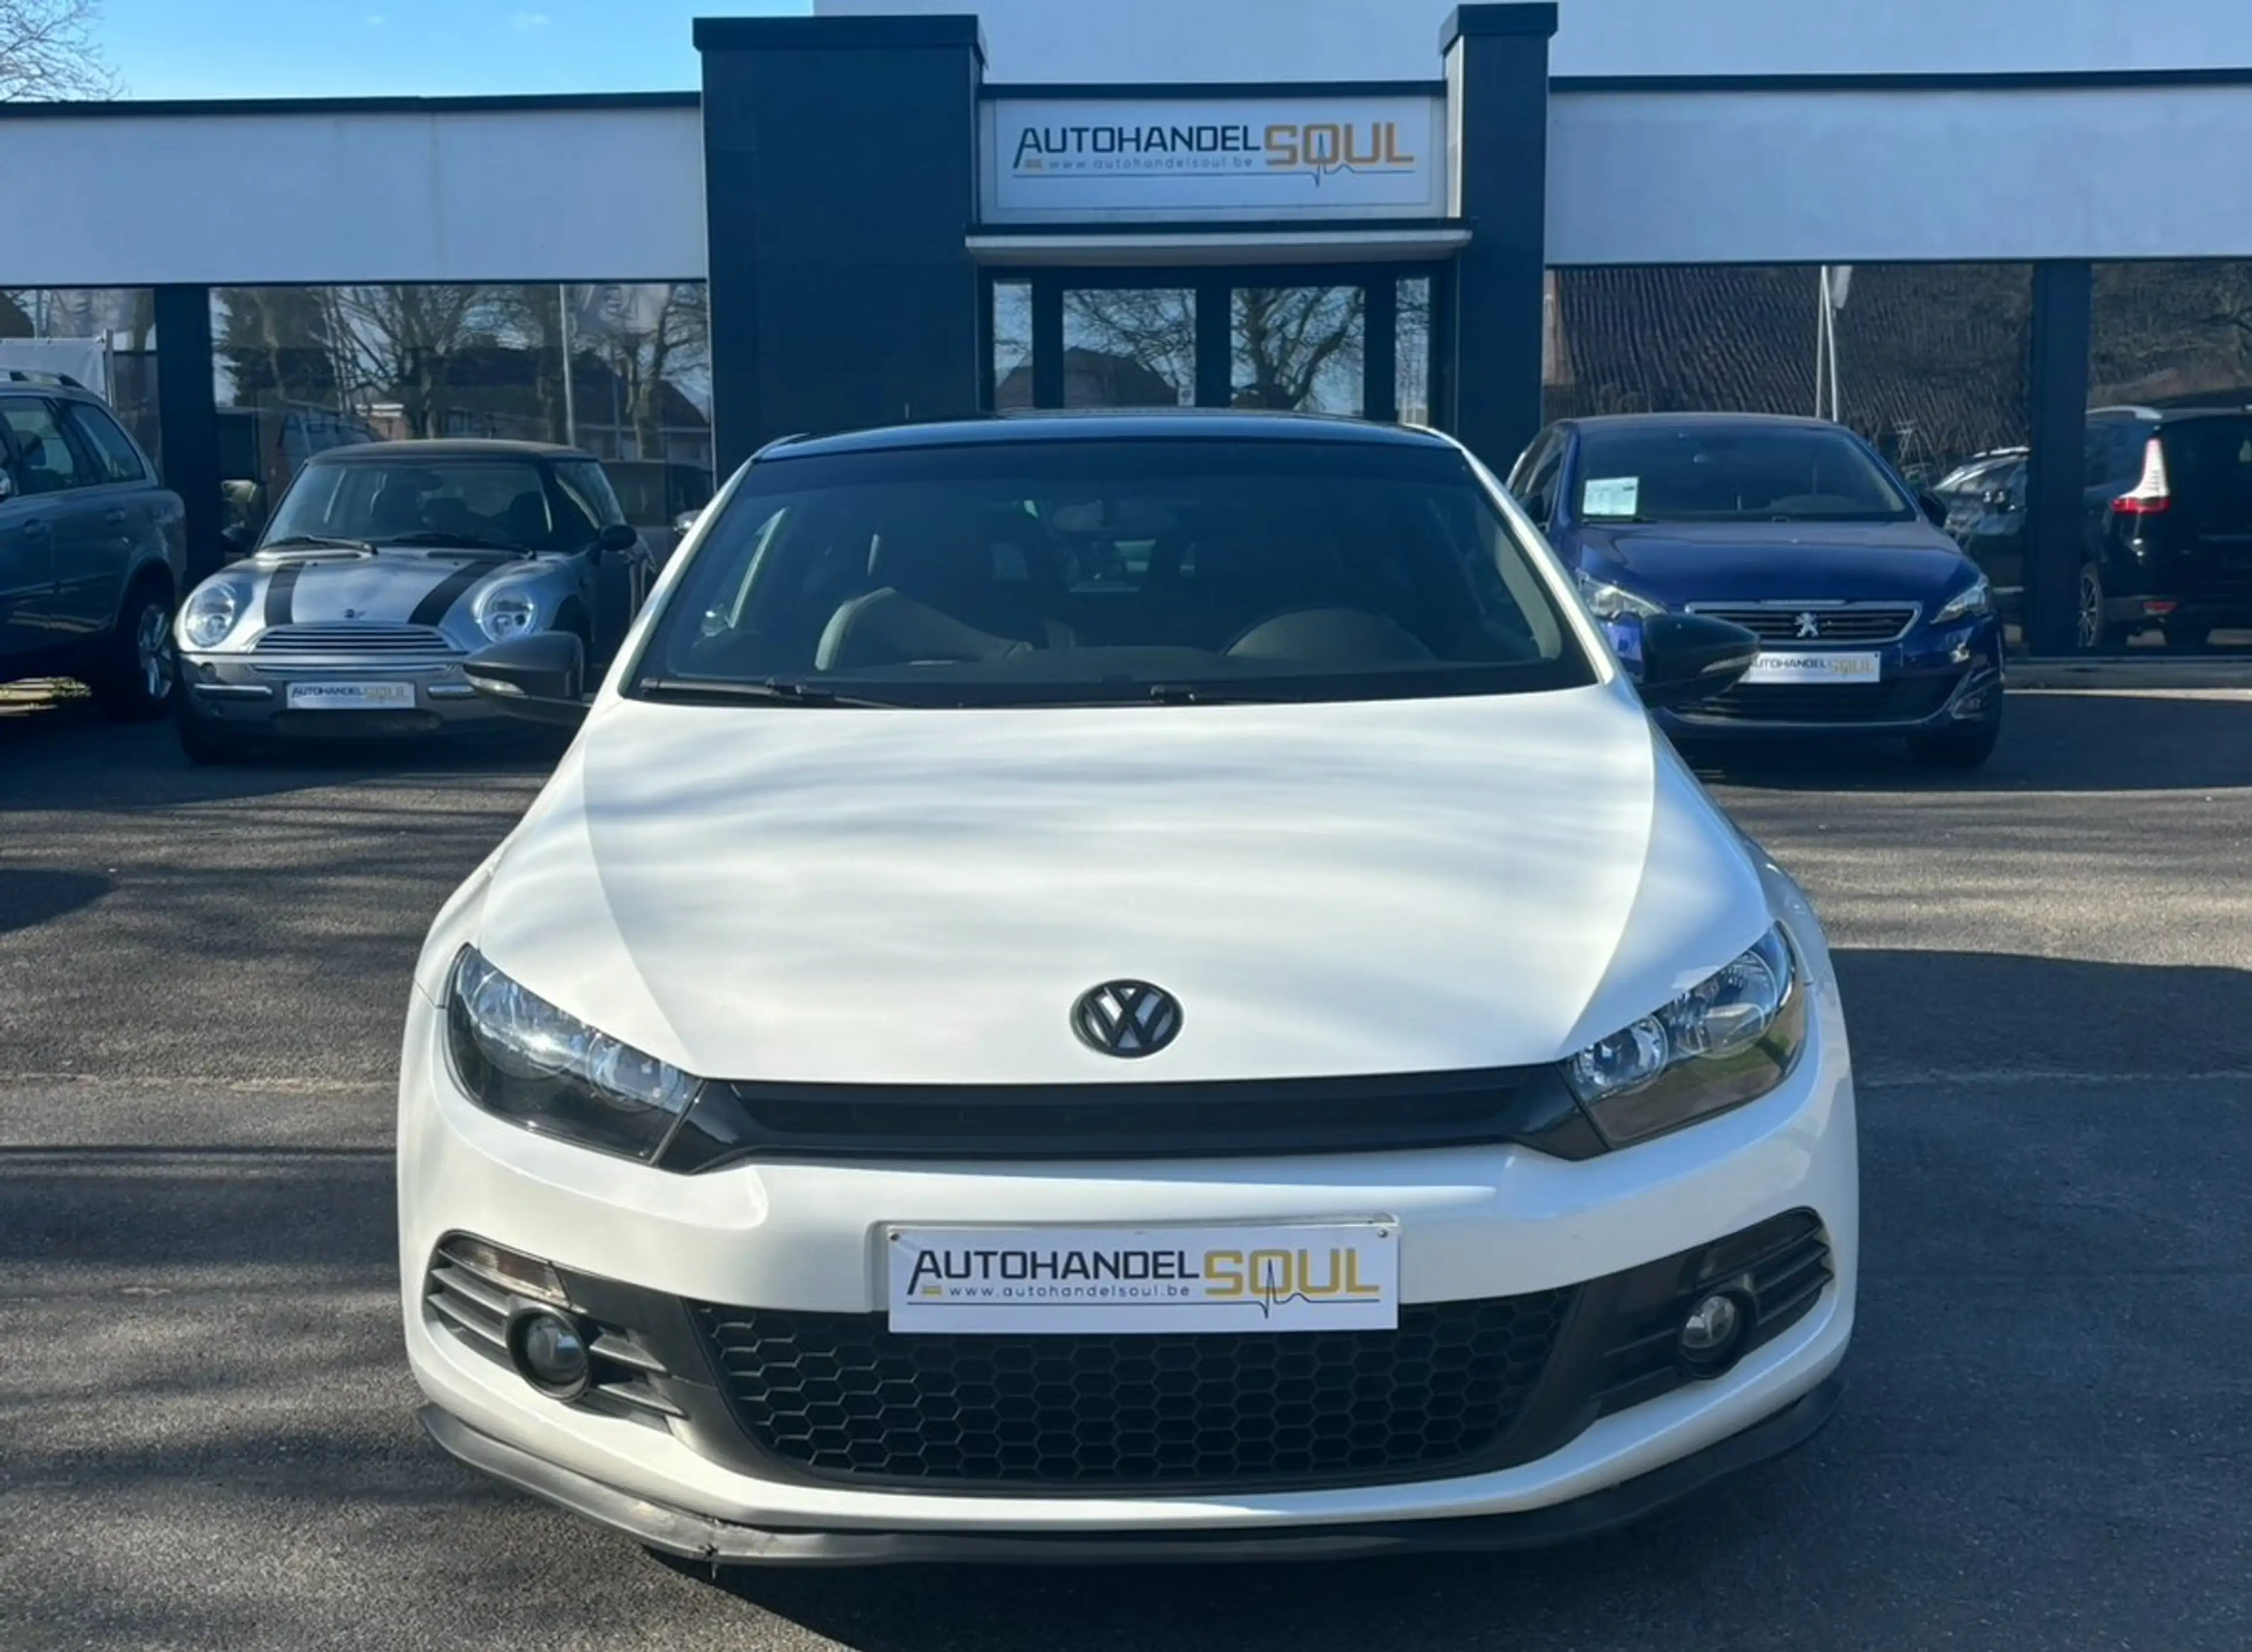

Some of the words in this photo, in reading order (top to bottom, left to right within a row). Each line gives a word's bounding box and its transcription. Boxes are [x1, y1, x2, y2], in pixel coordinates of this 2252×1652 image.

[1012, 125, 1261, 169] AUTOHANDEL
[1265, 122, 1415, 167] SOUL
[1049, 155, 1254, 169] www.autohandelsoul.be
[907, 1250, 1200, 1296] AUTOHANDEL
[1203, 1249, 1380, 1297] SOUL
[949, 1284, 1189, 1297] www.autohandelsoul.be
